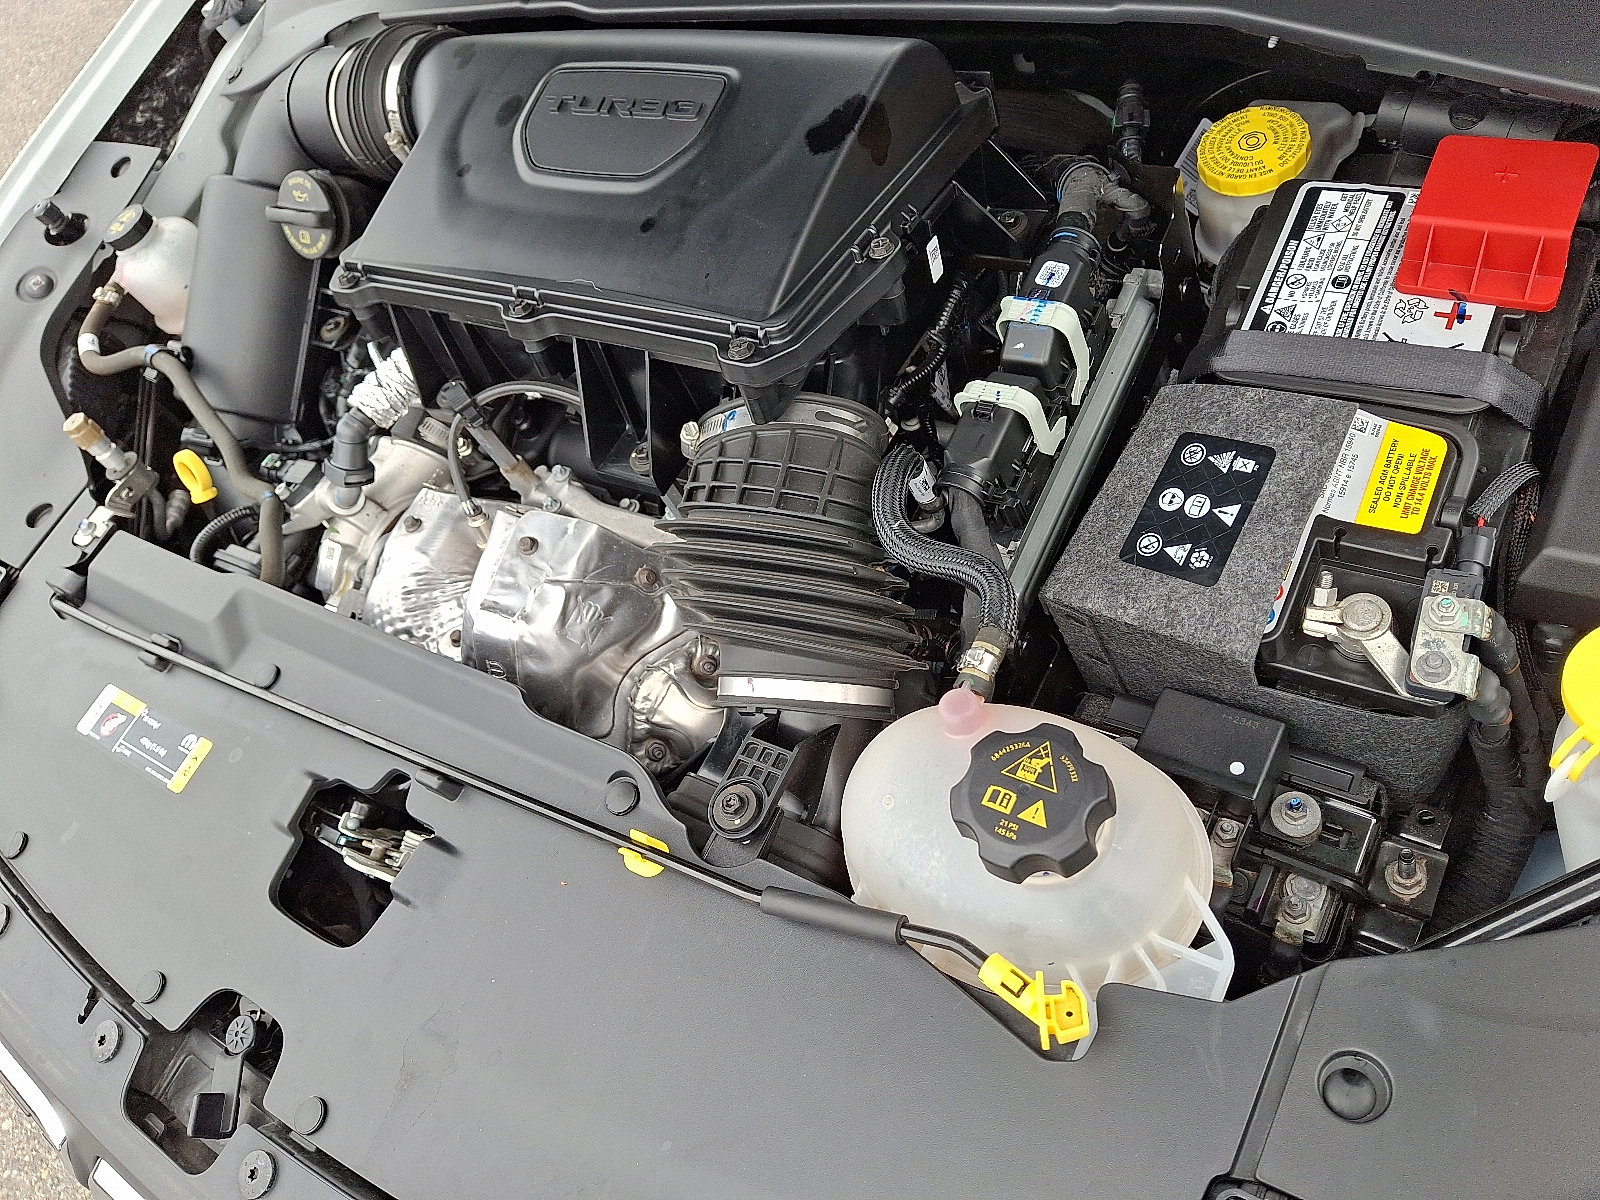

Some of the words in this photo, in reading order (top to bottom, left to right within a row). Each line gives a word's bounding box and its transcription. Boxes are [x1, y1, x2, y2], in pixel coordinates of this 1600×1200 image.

[546, 95, 704, 122] TURBO
[1245, 165, 1266, 173] AVANT
[1278, 158, 1291, 168] DOT
[1340, 193, 1349, 202] GET
[1343, 194, 1356, 213] MEDICAL
[1314, 203, 1324, 215] EYES
[1315, 201, 1331, 230] IMMEDIATELY
[1268, 240, 1299, 304] DANGER/POISON
[1426, 456, 1438, 471] MAX.
[1337, 480, 1348, 498] 15914
[1347, 454, 1359, 472] 15745
[1368, 486, 1383, 513] SEALED
[1379, 470, 1388, 485] AGM
[1384, 439, 1399, 469] BATTERY
[1382, 491, 1392, 502] DO
[1387, 475, 1396, 490] NOT
[1392, 453, 1404, 474] OPEN!
[1393, 453, 1417, 508] NON-SPILLABLE
[1400, 502, 1412, 519] LIMIT
[1406, 476, 1421, 500] CHARGE
[1414, 448, 1430, 475] VOLTAGE
[1419, 472, 1432, 491] VOLTS
[1322, 490, 1336, 514] Normas
[1414, 493, 1425, 505] 14.4
[1411, 507, 1420, 515] TO
[994, 826, 1006, 836] 145
[1005, 829, 1018, 841] kPa
[999, 818, 1008, 827] 21
[1008, 821, 1019, 832] PSI
